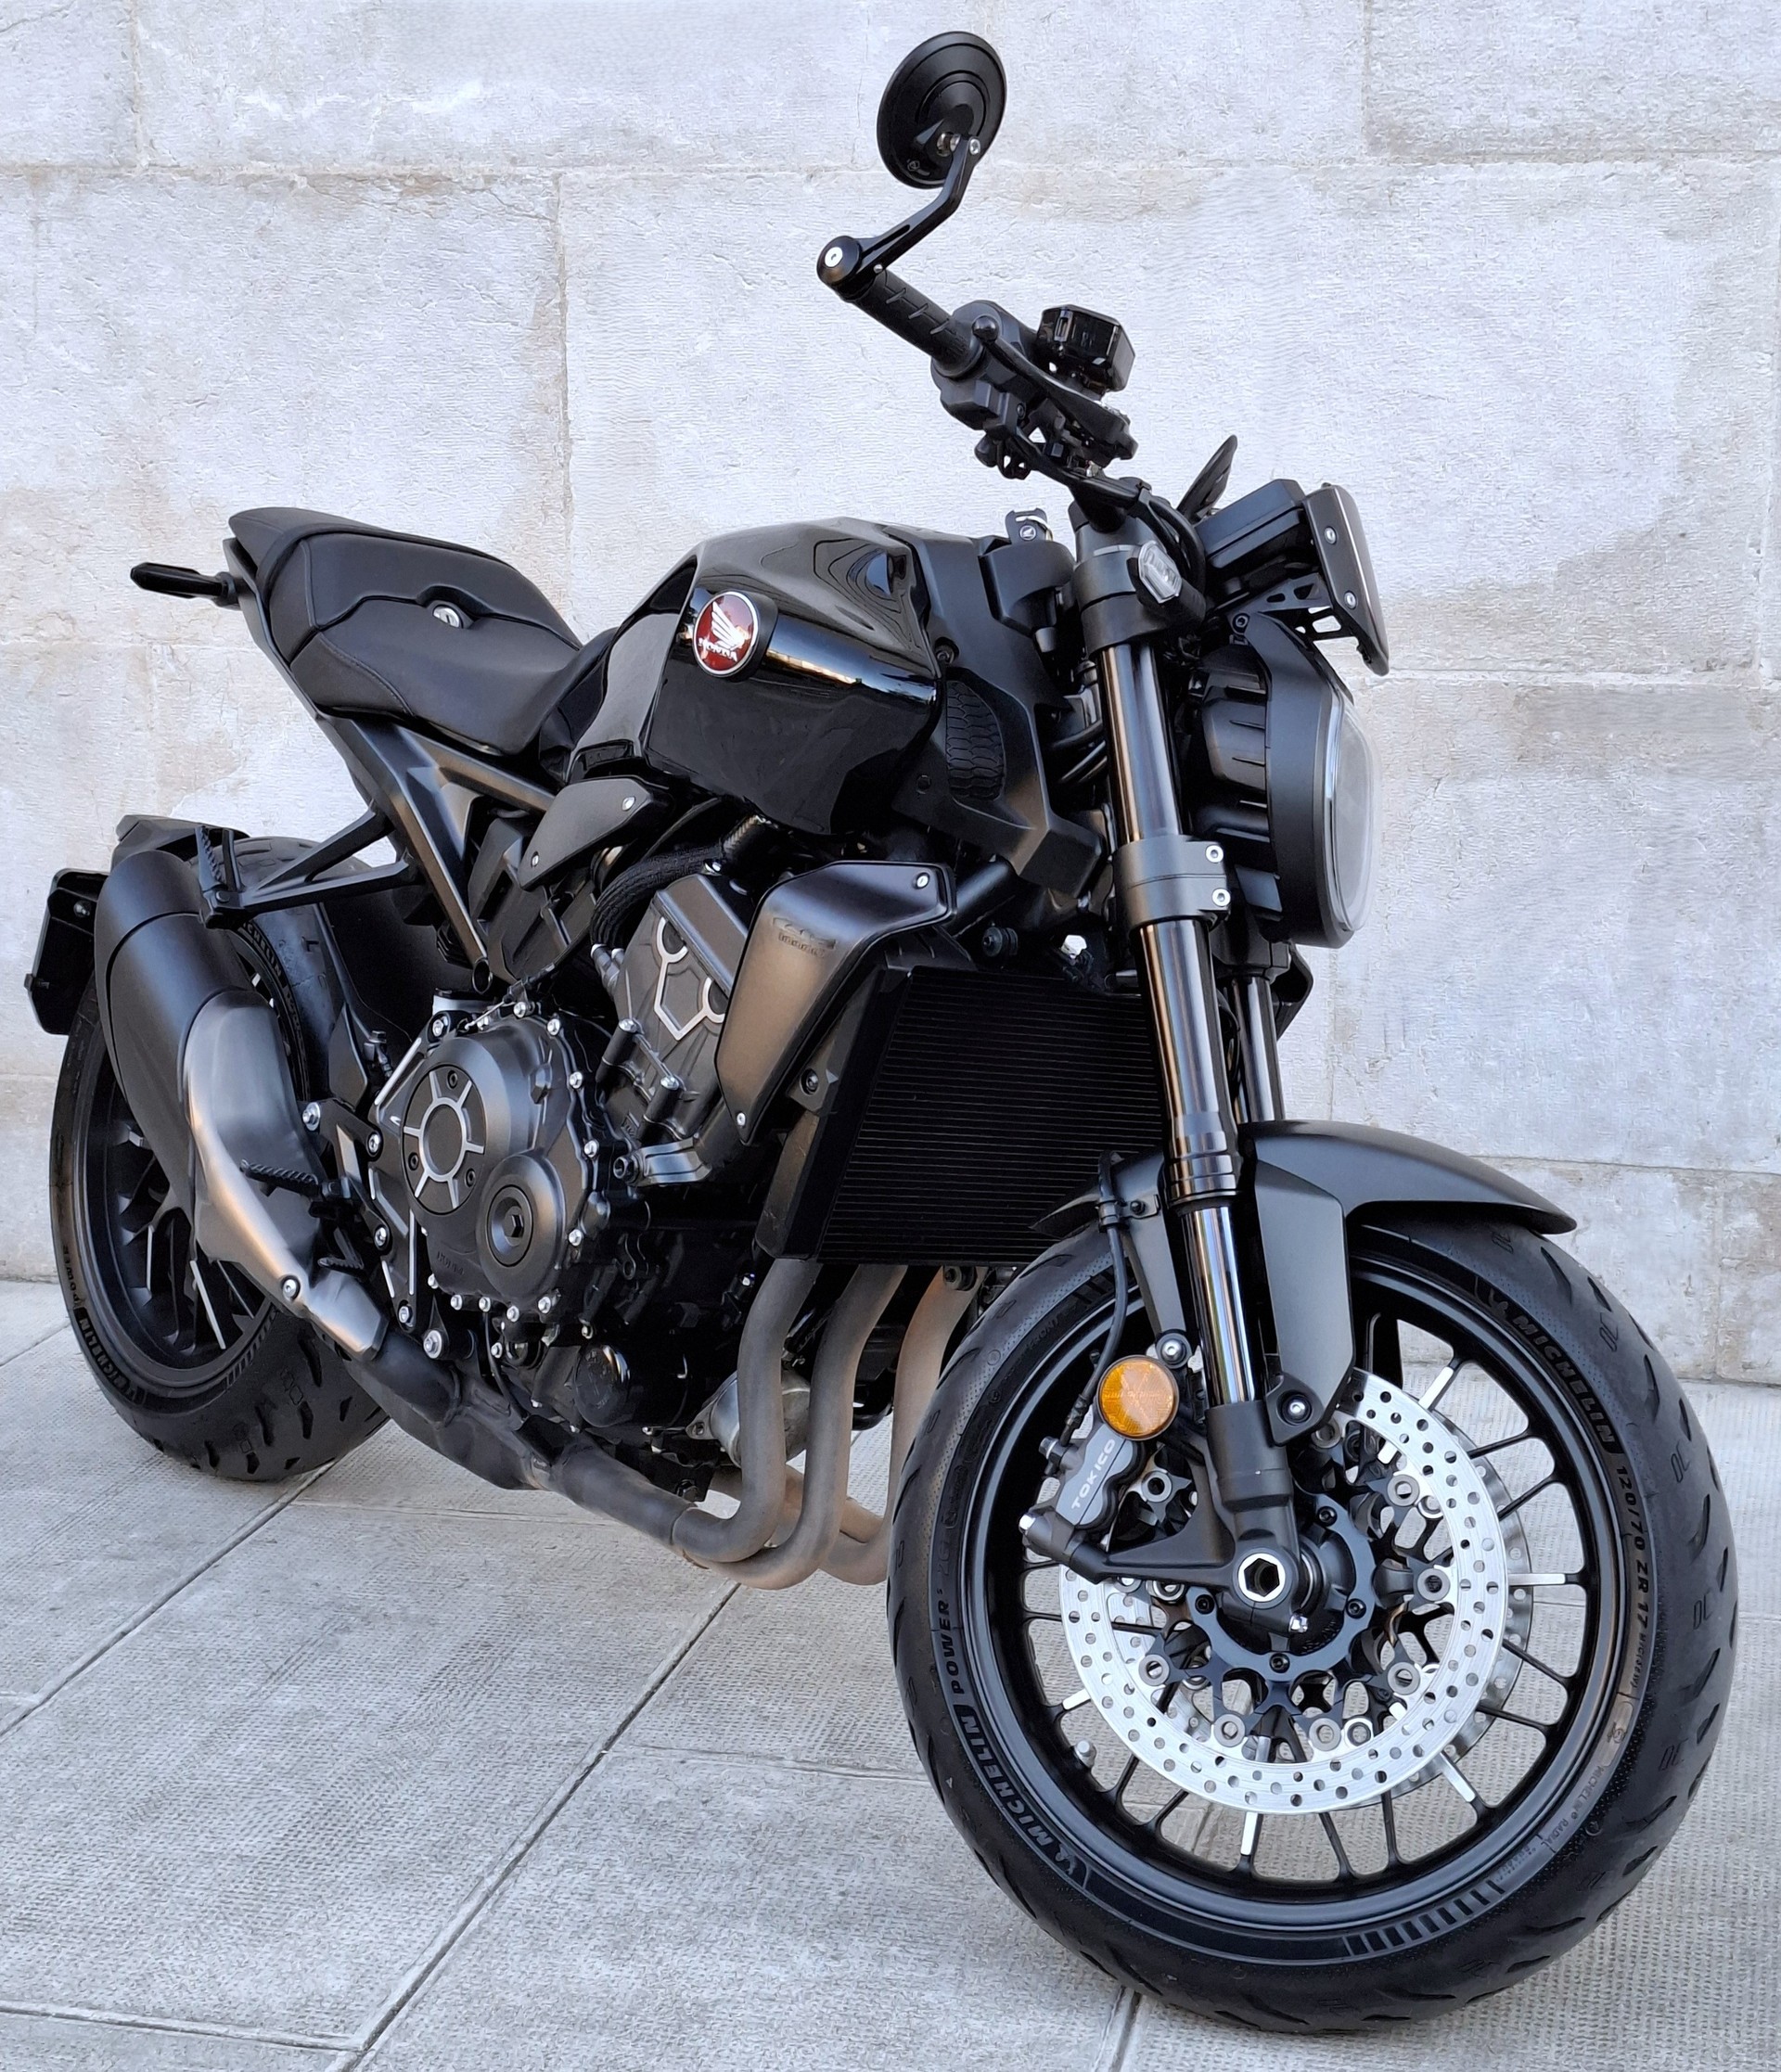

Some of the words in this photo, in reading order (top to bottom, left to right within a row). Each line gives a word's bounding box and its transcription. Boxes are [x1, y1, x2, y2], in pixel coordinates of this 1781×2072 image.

[1071, 1439, 1115, 1510] TOKICO
[1512, 1315, 1615, 1444] MICHELIN
[1616, 1465, 1646, 1551] 120/70
[937, 1599, 965, 1695] POWER
[961, 1714, 1053, 1847] MICHELIN
